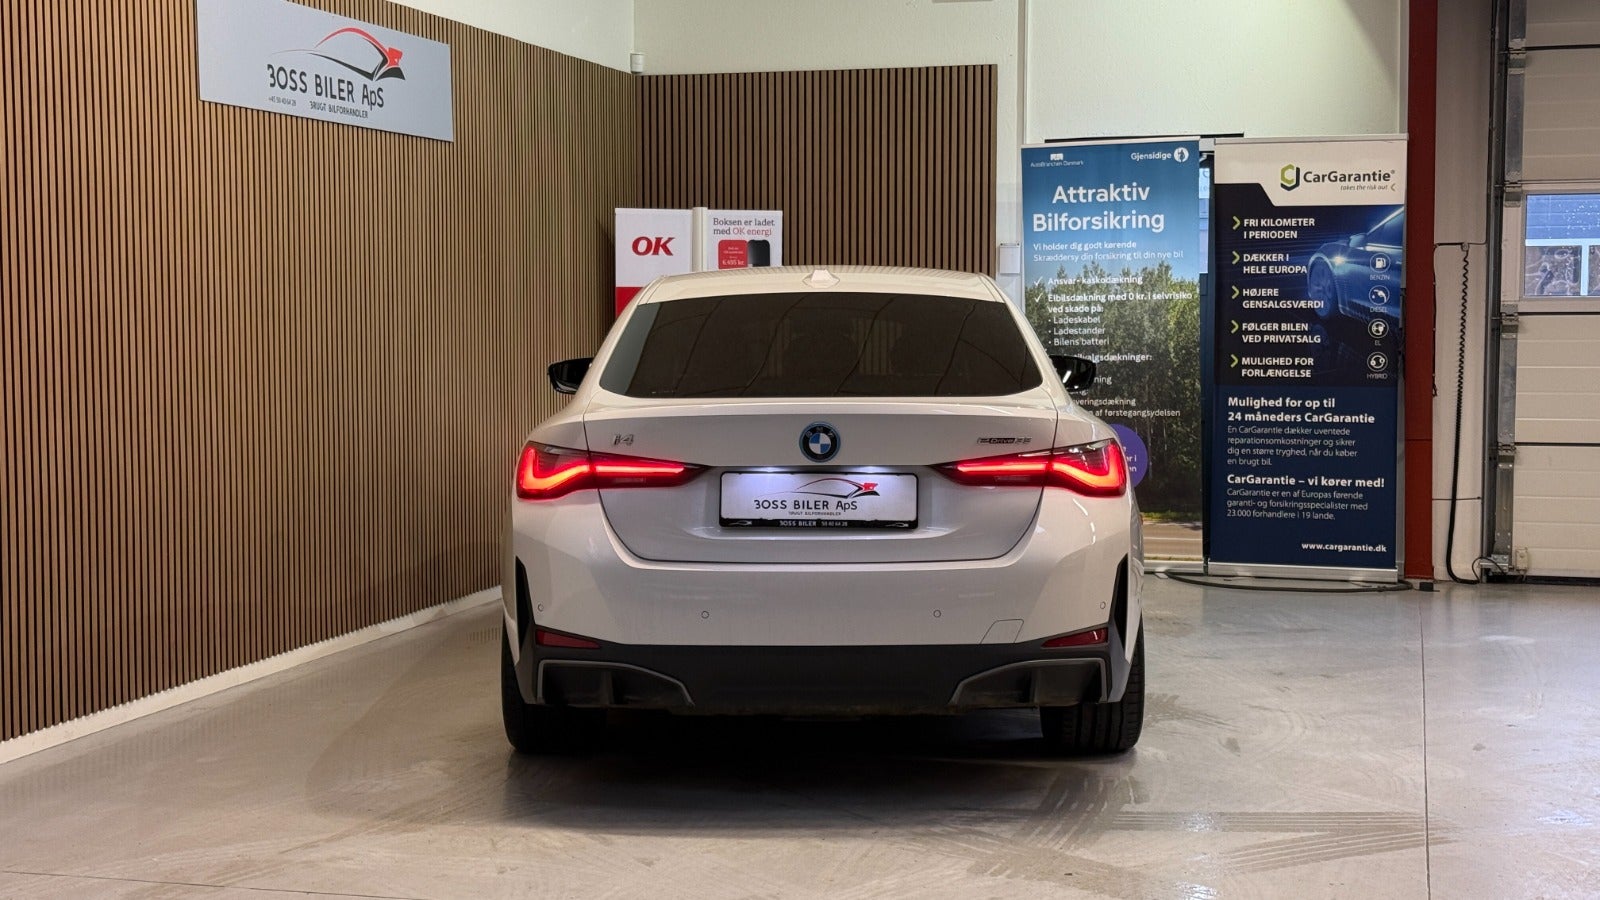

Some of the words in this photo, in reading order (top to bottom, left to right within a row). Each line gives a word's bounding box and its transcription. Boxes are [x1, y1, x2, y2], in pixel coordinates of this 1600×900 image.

[315, 74, 354, 103] BILER
[361, 83, 385, 111] ApS
[328, 104, 368, 118] BILFORHANDLER
[1130, 152, 1172, 161] Gjensidige
[1052, 182, 1150, 204] Attraktiv
[713, 218, 742, 226] Boksen
[1033, 210, 1165, 232] Bilforsikring
[1243, 219, 1259, 227] FRI
[1261, 218, 1315, 227] KILOMETER
[747, 228, 772, 237] energi
[1243, 231, 1247, 239] I
[1249, 231, 1298, 239] PERIODEN
[631, 236, 676, 256] OK
[1042, 242, 1068, 250] holder
[1069, 242, 1083, 251] dig
[1084, 242, 1103, 250] godt
[1104, 241, 1137, 249] kørende
[1033, 253, 1078, 262] Skræddersy
[1081, 253, 1093, 261] din
[1095, 252, 1132, 262] forsikring
[1157, 252, 1172, 260] nye
[1243, 253, 1284, 262] DÆKKER
[1285, 253, 1289, 261] I
[1243, 266, 1267, 274] HELE
[1268, 266, 1308, 274] EUROPA
[1047, 277, 1080, 285] Ansvar-
[1082, 276, 1143, 285] kaskodækning
[1242, 288, 1279, 297] HØJERE
[1047, 293, 1106, 303] Elbilsdækning
[1107, 293, 1127, 301] med
[1136, 292, 1147, 300] kr.
[1152, 292, 1192, 300] selvrisiko
[1064, 305, 1090, 313] skade
[1091, 305, 1104, 314] på:
[1242, 301, 1324, 309] GENSALGSVÆRDI
[1053, 316, 1101, 325] Ladeskabel
[1053, 327, 1105, 335] Ladestander
[1242, 323, 1279, 331] FØLGER
[1280, 323, 1309, 331] BILEN
[1053, 338, 1080, 346] Bilens
[1241, 335, 1262, 343] VED
[1263, 335, 1321, 343] PRIVATSALG
[1241, 357, 1293, 366] MULIGHED
[1294, 357, 1314, 366] FOR
[1241, 369, 1312, 377] FORLÆNGELSE
[1228, 397, 1283, 409] Mulighed
[1285, 397, 1302, 407] for
[1304, 399, 1320, 410] op
[1322, 398, 1336, 408] til
[1095, 409, 1103, 417] af
[1104, 409, 1181, 417] førstegangsydelsen
[1227, 412, 1242, 421] 24
[1244, 411, 1302, 422] måneders
[1304, 412, 1375, 423] CarGarantie
[1238, 426, 1283, 434] CarGarantie
[1283, 427, 1313, 435] dækker
[1314, 427, 1350, 435] uventede
[1227, 437, 1322, 446] reparationsomkostninger
[1323, 439, 1334, 447] og
[1335, 438, 1356, 446] sikrer
[1275, 448, 1308, 457] tryghed,
[1309, 449, 1321, 457] når
[1322, 449, 1334, 457] du
[1335, 449, 1358, 457] køber
[1238, 458, 1260, 466] brugt
[1226, 474, 1296, 485] CarGarantie
[1307, 477, 1318, 486] vi
[1321, 476, 1352, 487] kører
[1355, 478, 1385, 488] med!
[1226, 488, 1271, 497] CarGarantie
[1301, 490, 1332, 499] Europas
[793, 500, 829, 510] BILER
[835, 500, 858, 512] ApS
[1226, 500, 1256, 508] garanti-
[1257, 501, 1268, 509] og
[1269, 501, 1349, 510] forsikringsspecialister
[1350, 503, 1369, 511] med
[1252, 510, 1296, 519] forhandlere
[1312, 512, 1336, 520] lande.
[1301, 543, 1387, 552] www.cargarantie.dk
